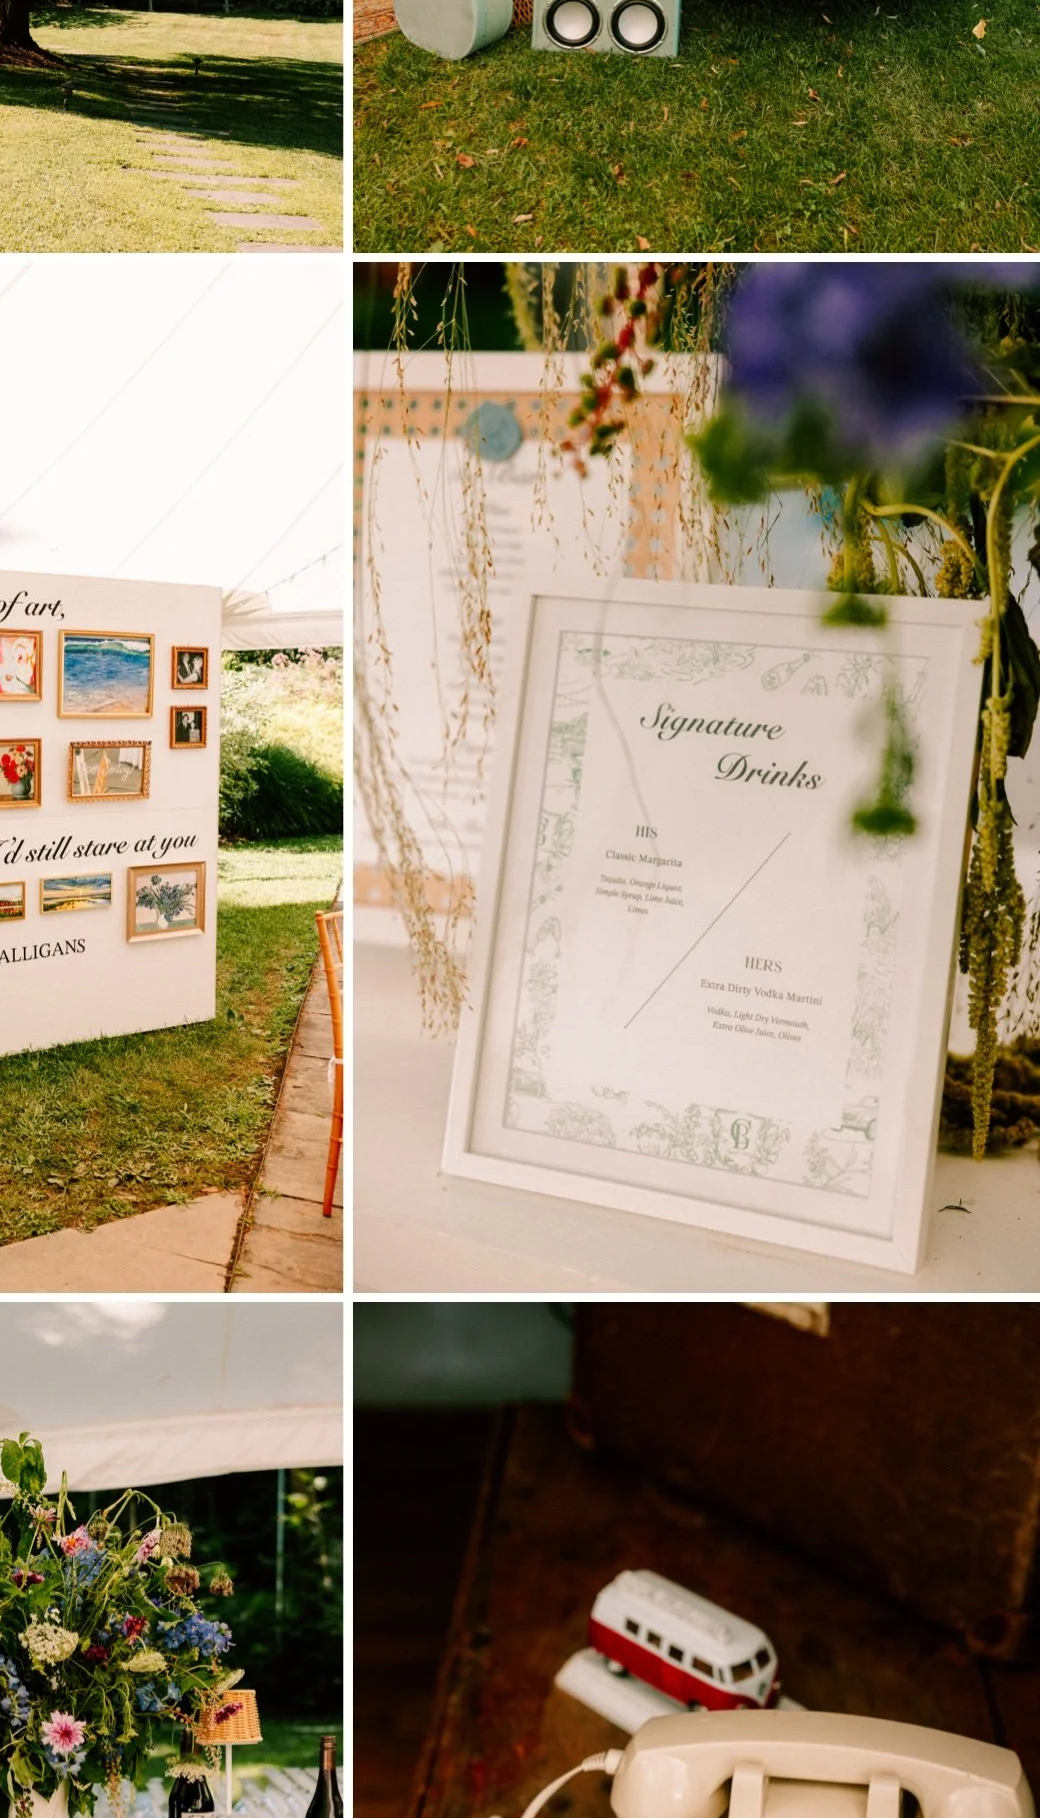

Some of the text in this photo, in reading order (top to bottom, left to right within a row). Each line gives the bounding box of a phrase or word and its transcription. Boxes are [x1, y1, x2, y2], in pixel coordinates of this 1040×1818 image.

[24, 598, 65, 620] art,
[640, 702, 787, 742] Signature
[714, 752, 827, 791] Drinks
[635, 825, 658, 840] HIS
[25, 835, 73, 862] still
[73, 836, 130, 859] stare
[134, 834, 158, 853] at
[152, 834, 199, 860] you
[605, 850, 683, 869] Classic Margarita
[629, 877, 657, 891] Orange
[595, 887, 685, 908] Simple Syrup, Lime Juice,
[627, 904, 649, 916] Limes
[744, 956, 783, 973] HERS
[700, 979, 823, 1006] Extra Dirty Vodka Martini
[707, 1005, 810, 1031] Vodka, Light Dry Vermouth,
[712, 1020, 802, 1042] Extra Olive Juice, Olives
